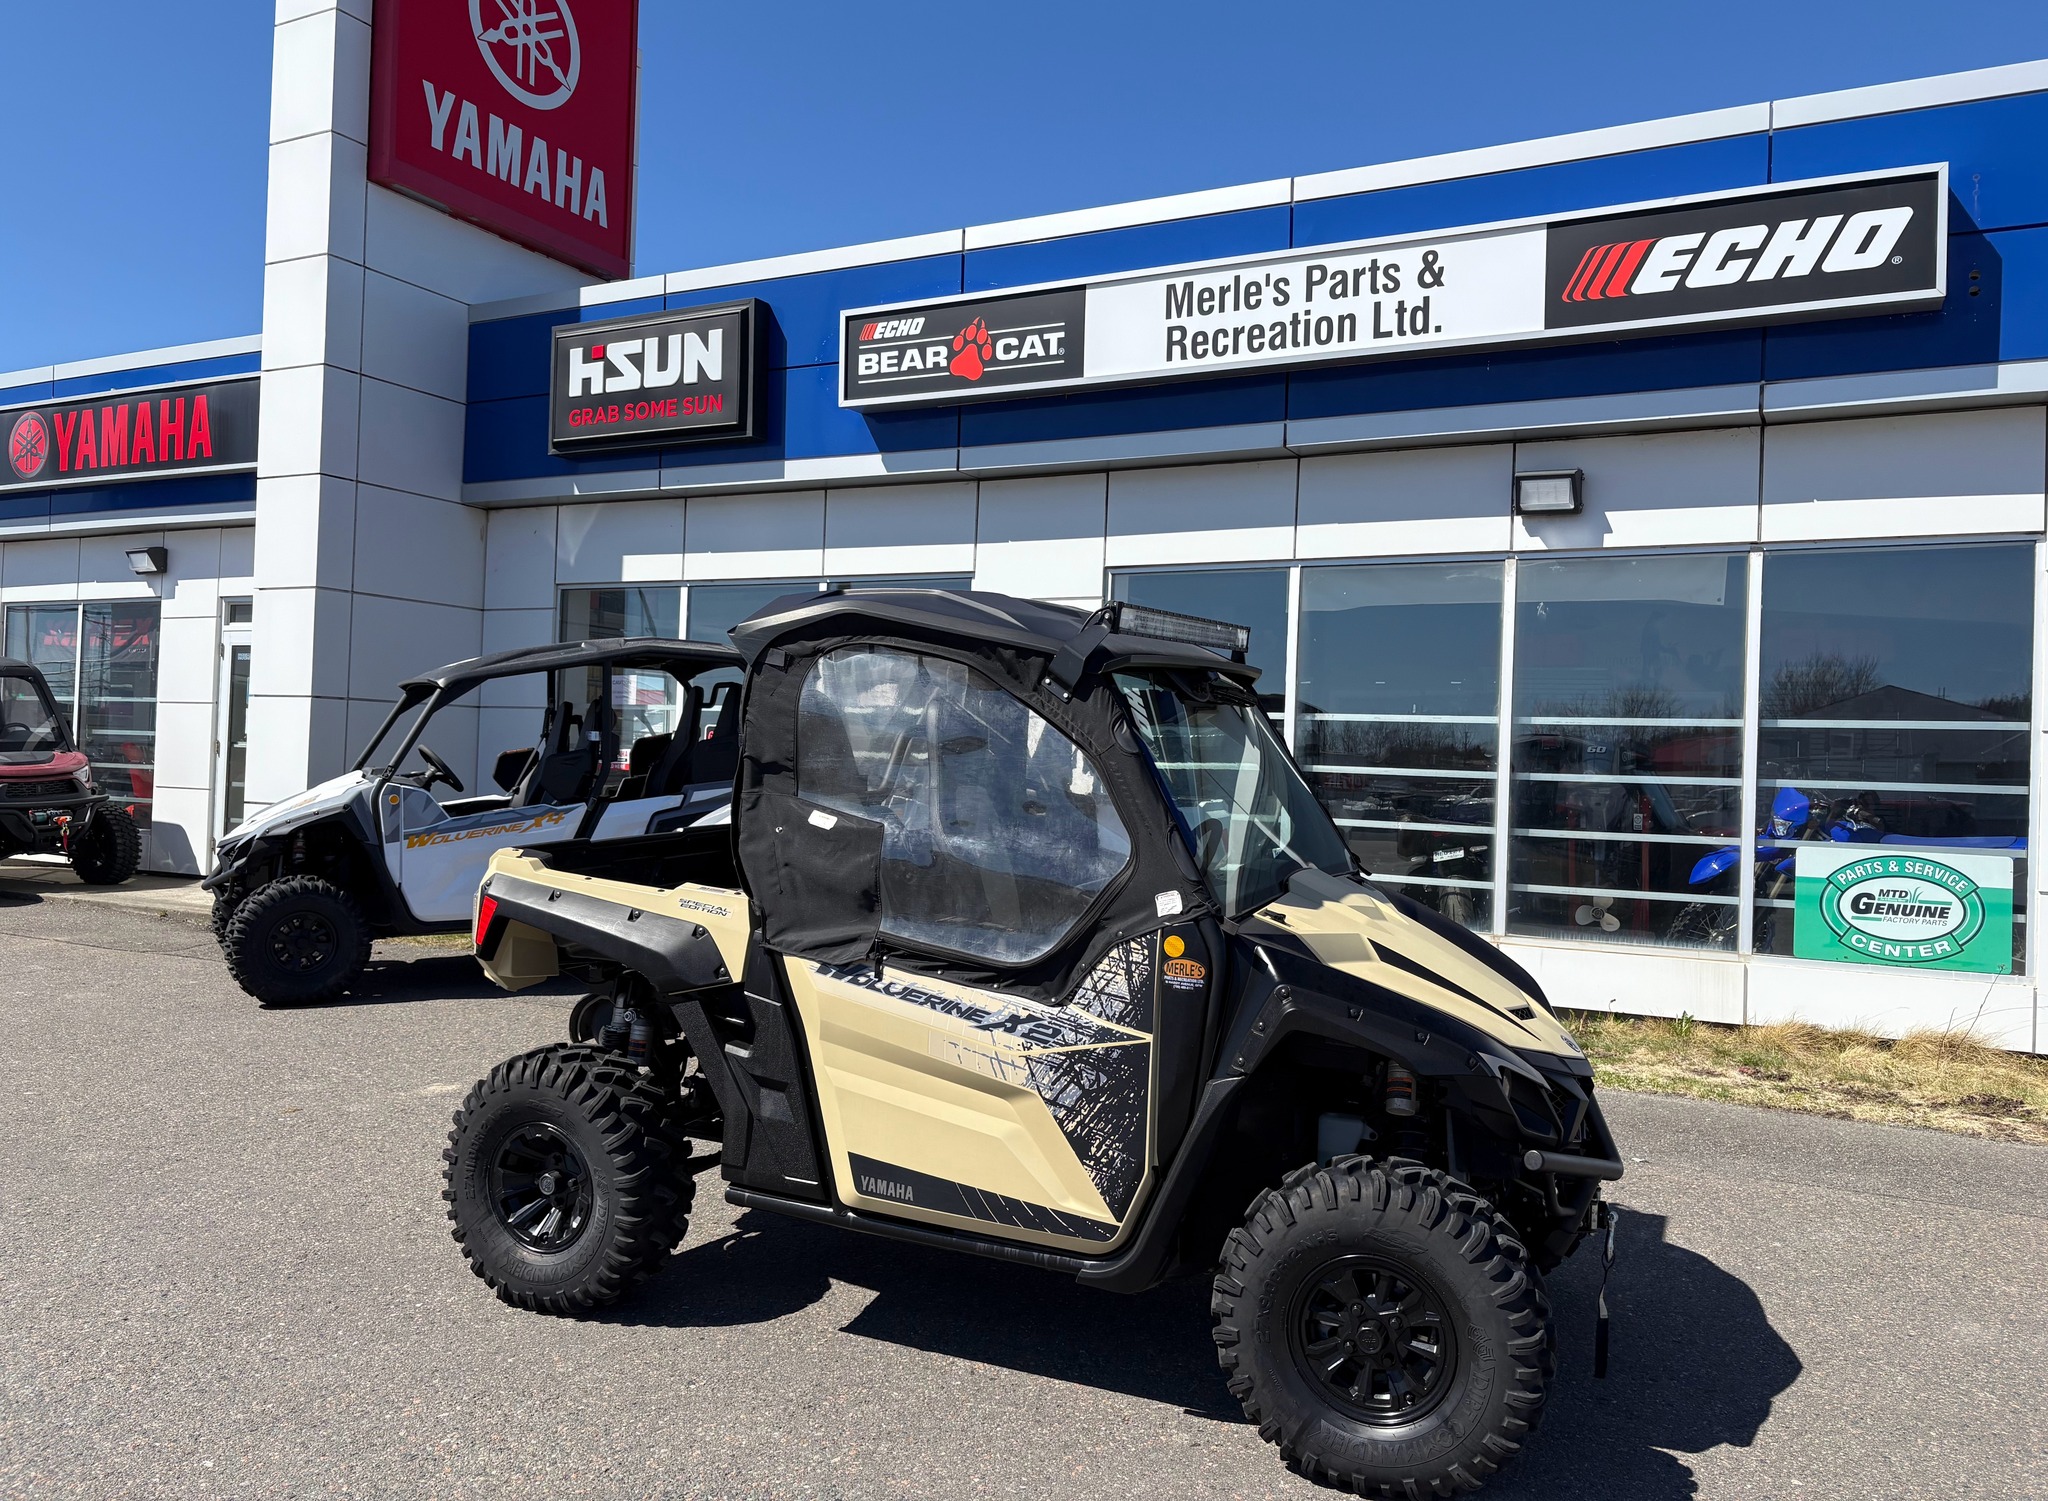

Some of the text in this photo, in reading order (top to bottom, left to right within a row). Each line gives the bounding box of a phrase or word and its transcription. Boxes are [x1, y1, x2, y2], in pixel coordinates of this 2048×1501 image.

[422, 79, 608, 228] YAMAHA
[1630, 206, 1914, 296] ECHO
[1165, 250, 1446, 320] Merle's Parts &
[873, 317, 926, 340] ECHO
[1165, 295, 1443, 362] Recreation Ltd.
[858, 331, 1065, 376] BEAR CAT
[568, 394, 723, 427] GRAB SOME SUN
[53, 394, 213, 472] YAMAHA
[406, 811, 566, 849] WOLVERINE X4
[1837, 860, 1969, 894] PARTS & SERVICE
[1878, 888, 1909, 899] MTD
[679, 898, 731, 913] SPECIAL
[680, 903, 728, 917] EDITION
[1850, 892, 1952, 920] GENUINE
[1882, 916, 1948, 927] FACTORY PARTS
[1850, 934, 1952, 958] CENTER
[1166, 962, 1202, 977] MERLE'S
[815, 961, 1064, 1046] WOLVERINE X2
[860, 1174, 914, 1202] YAMAHA
